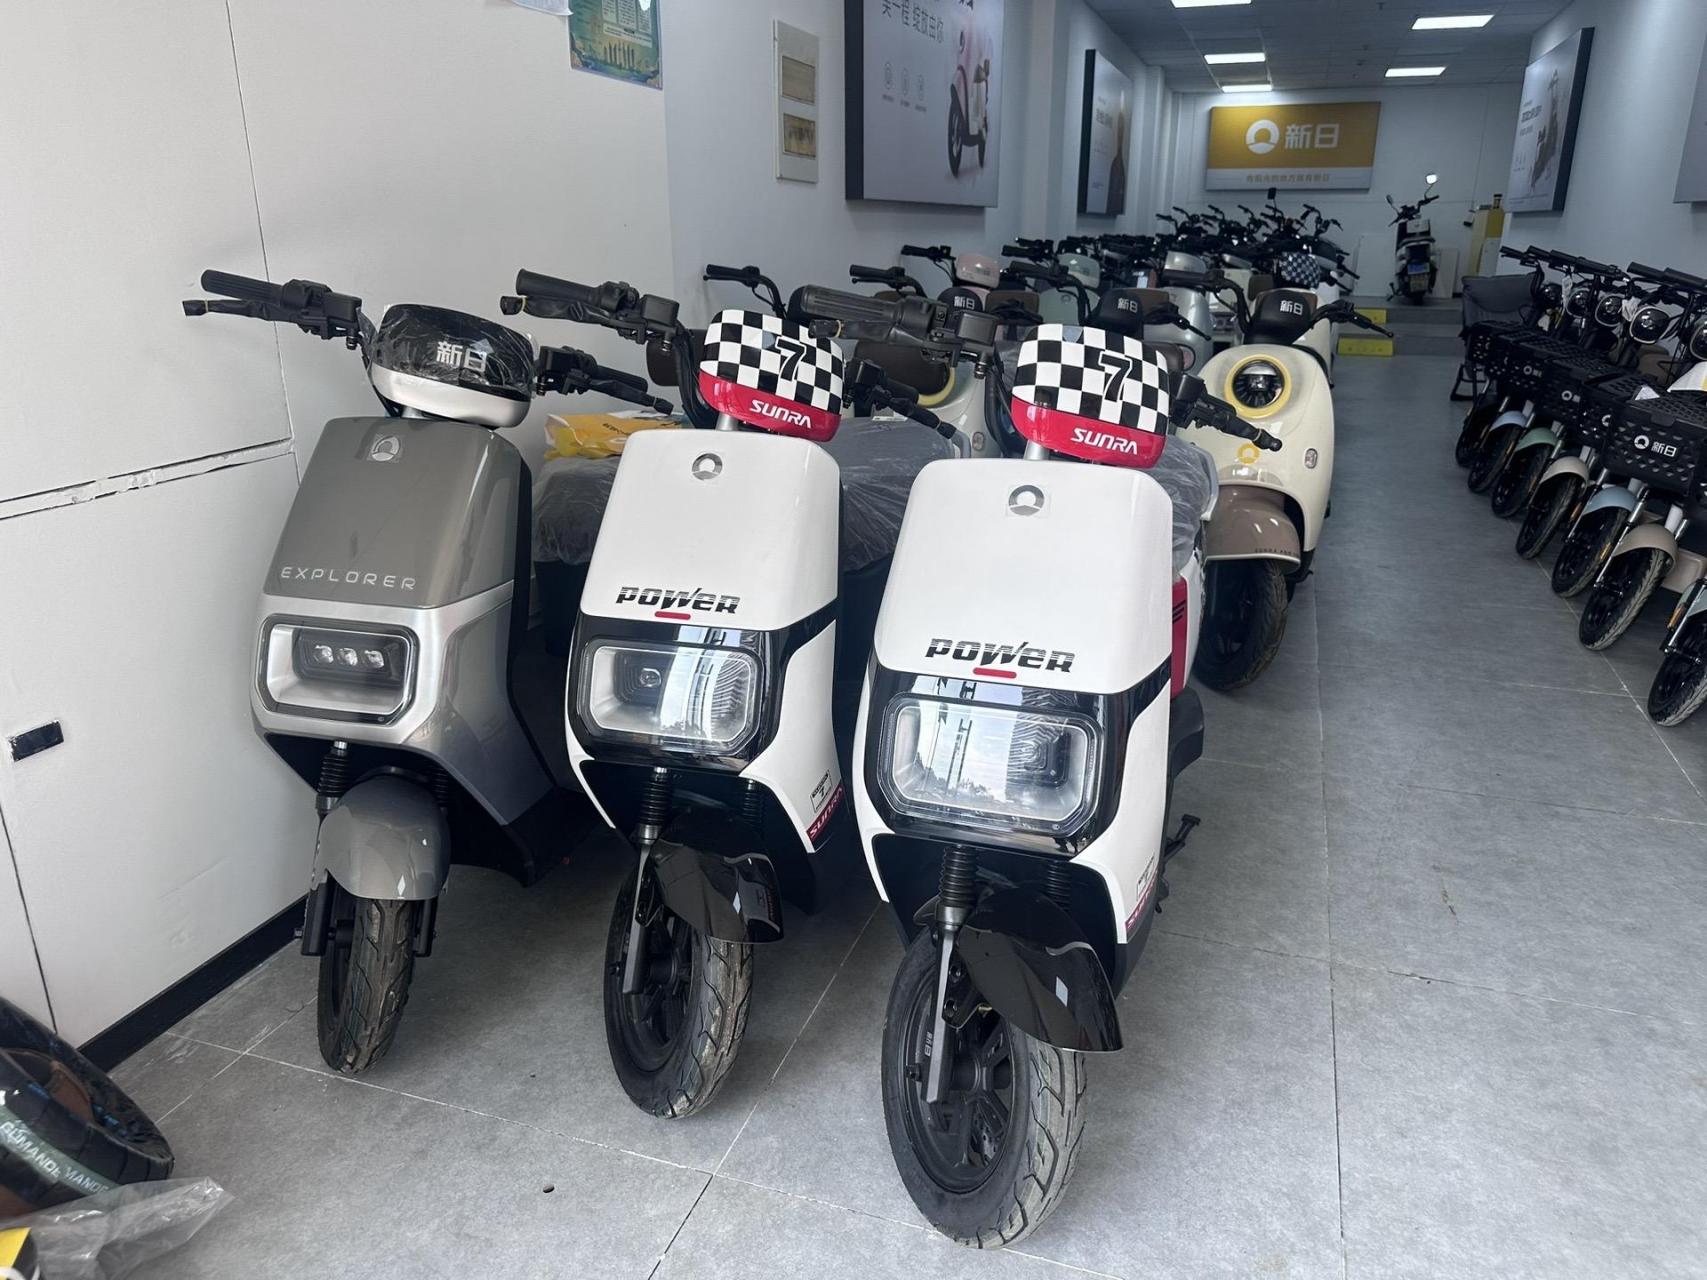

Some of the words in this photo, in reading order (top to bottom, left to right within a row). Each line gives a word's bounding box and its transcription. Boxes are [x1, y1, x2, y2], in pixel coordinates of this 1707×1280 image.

[1285, 123, 1340, 150] 新日
[953, 295, 975, 310] 新日
[1117, 297, 1138, 313] 新日
[1280, 299, 1303, 316] 新日
[436, 340, 488, 373] 新日
[775, 335, 807, 382] 7
[1098, 349, 1133, 403] 7
[749, 399, 812, 429] SUNRA
[1070, 427, 1138, 456] SUNRA
[1650, 440, 1678, 458] 新日
[280, 566, 416, 590] EXPLORER
[615, 587, 741, 614] POWER
[924, 640, 1076, 673] POWER
